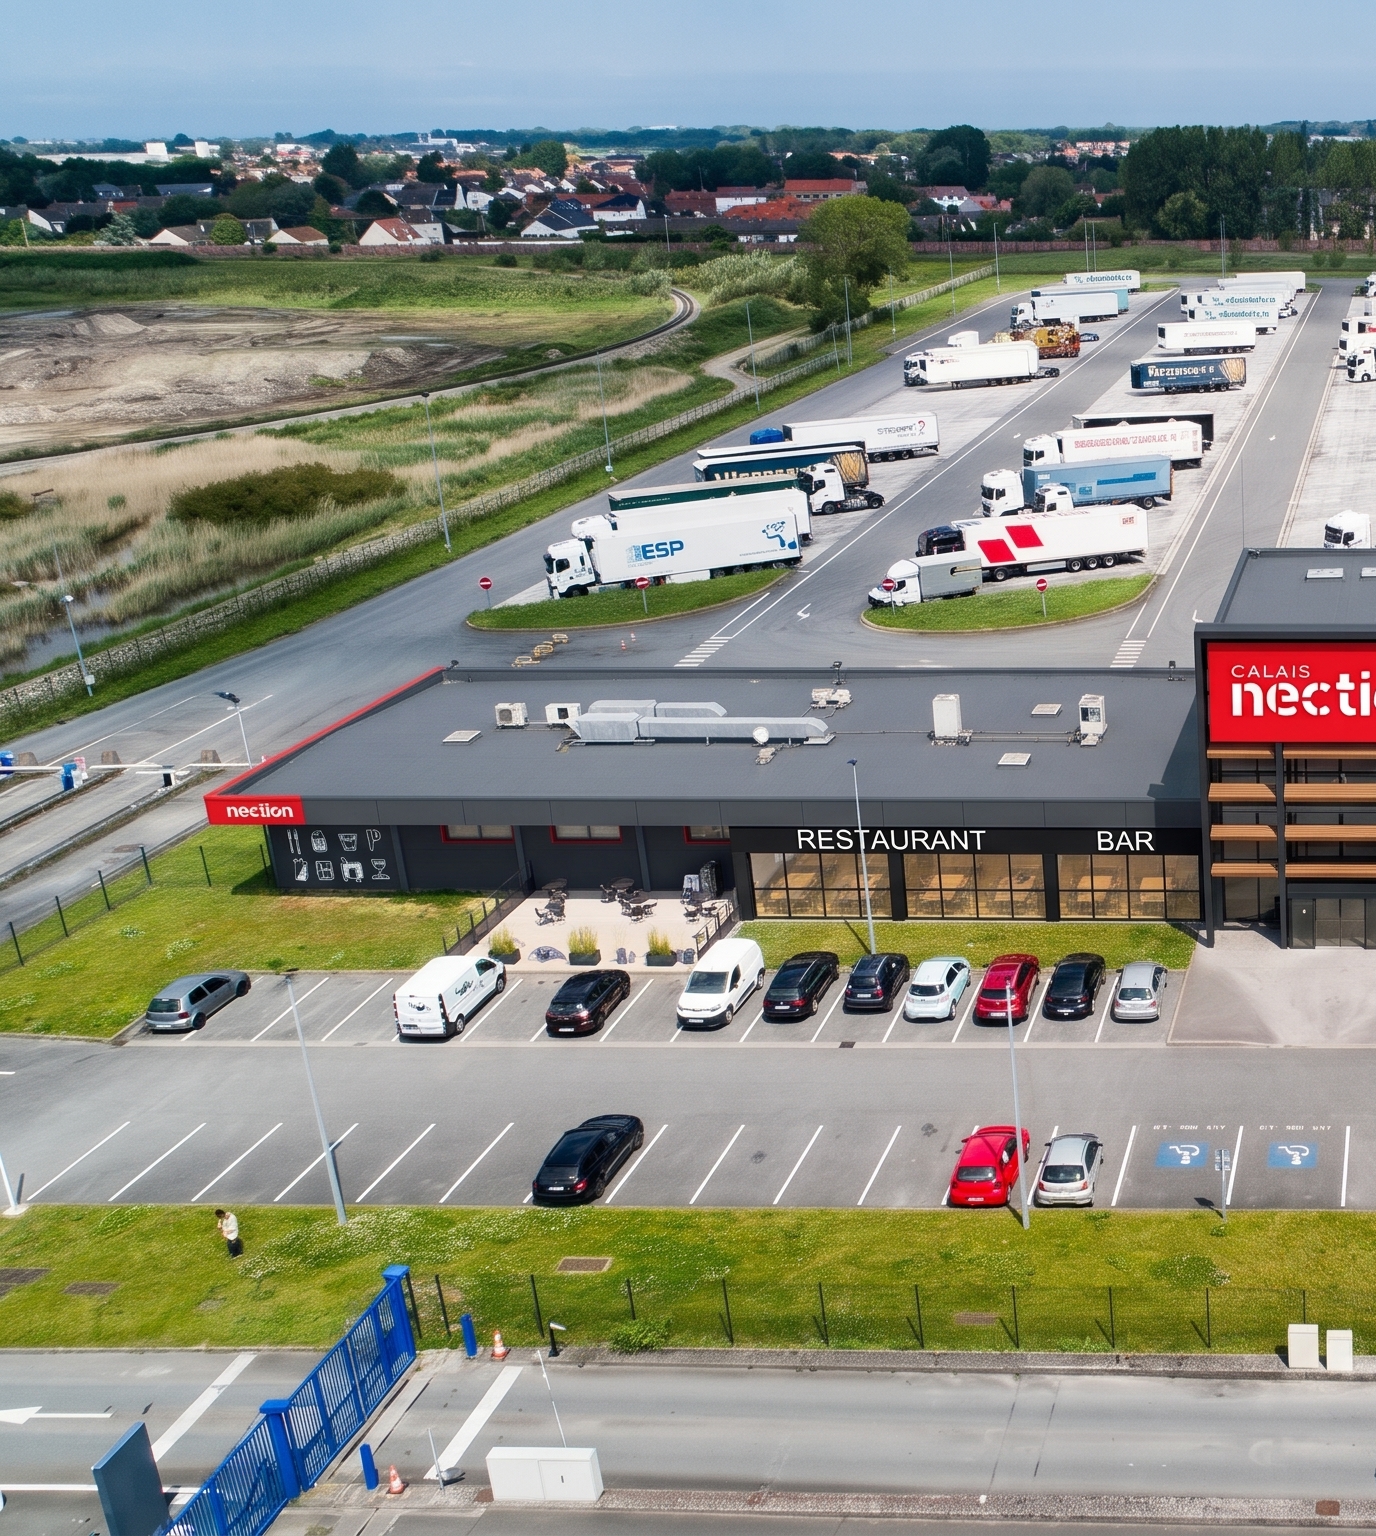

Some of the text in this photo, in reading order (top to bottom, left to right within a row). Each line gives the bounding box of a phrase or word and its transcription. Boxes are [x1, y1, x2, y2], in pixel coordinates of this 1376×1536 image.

[1231, 665, 1311, 678] CALAIS
[797, 829, 986, 851] RESTAURANT
[1097, 830, 1155, 851] BAR
